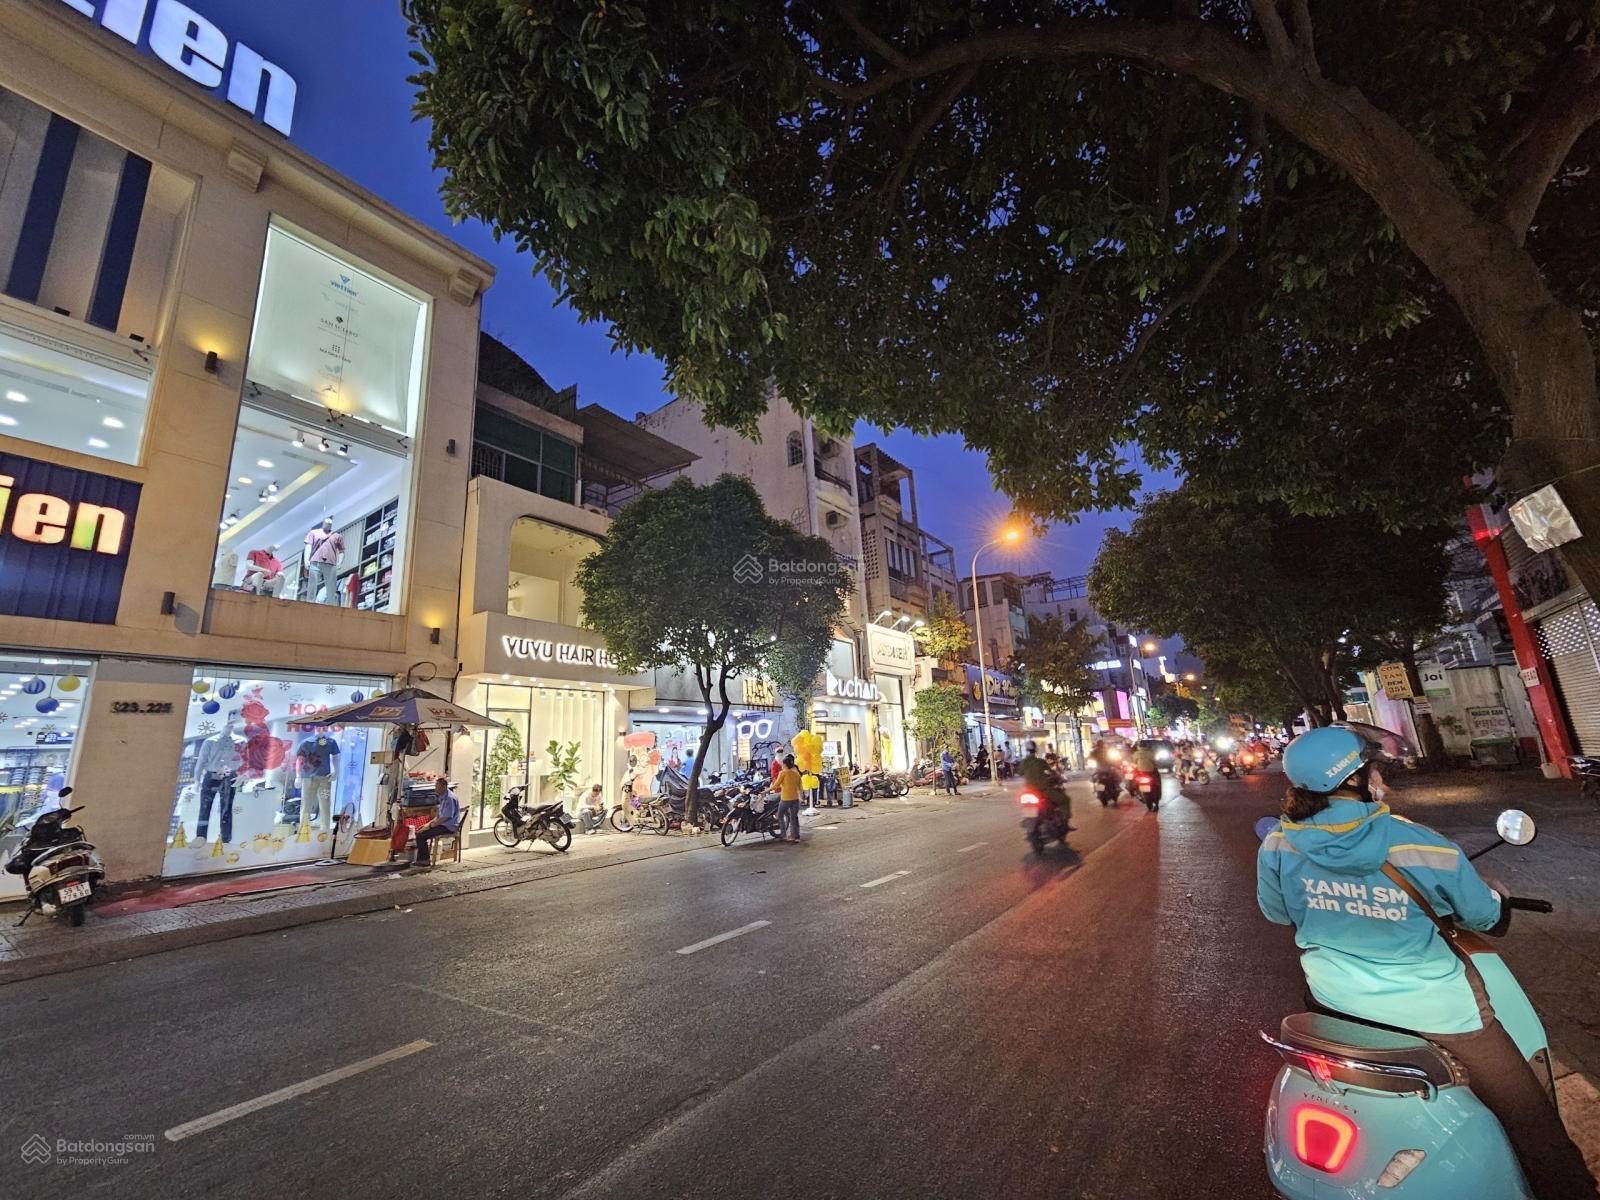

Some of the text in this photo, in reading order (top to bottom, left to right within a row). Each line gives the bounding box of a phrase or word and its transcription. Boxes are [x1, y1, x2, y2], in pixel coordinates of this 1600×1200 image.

[504, 637, 553, 660] VUYU
[556, 643, 594, 665] HAIR
[1301, 878, 1409, 905] XANH SM
[1307, 896, 1408, 921] xin chào!
